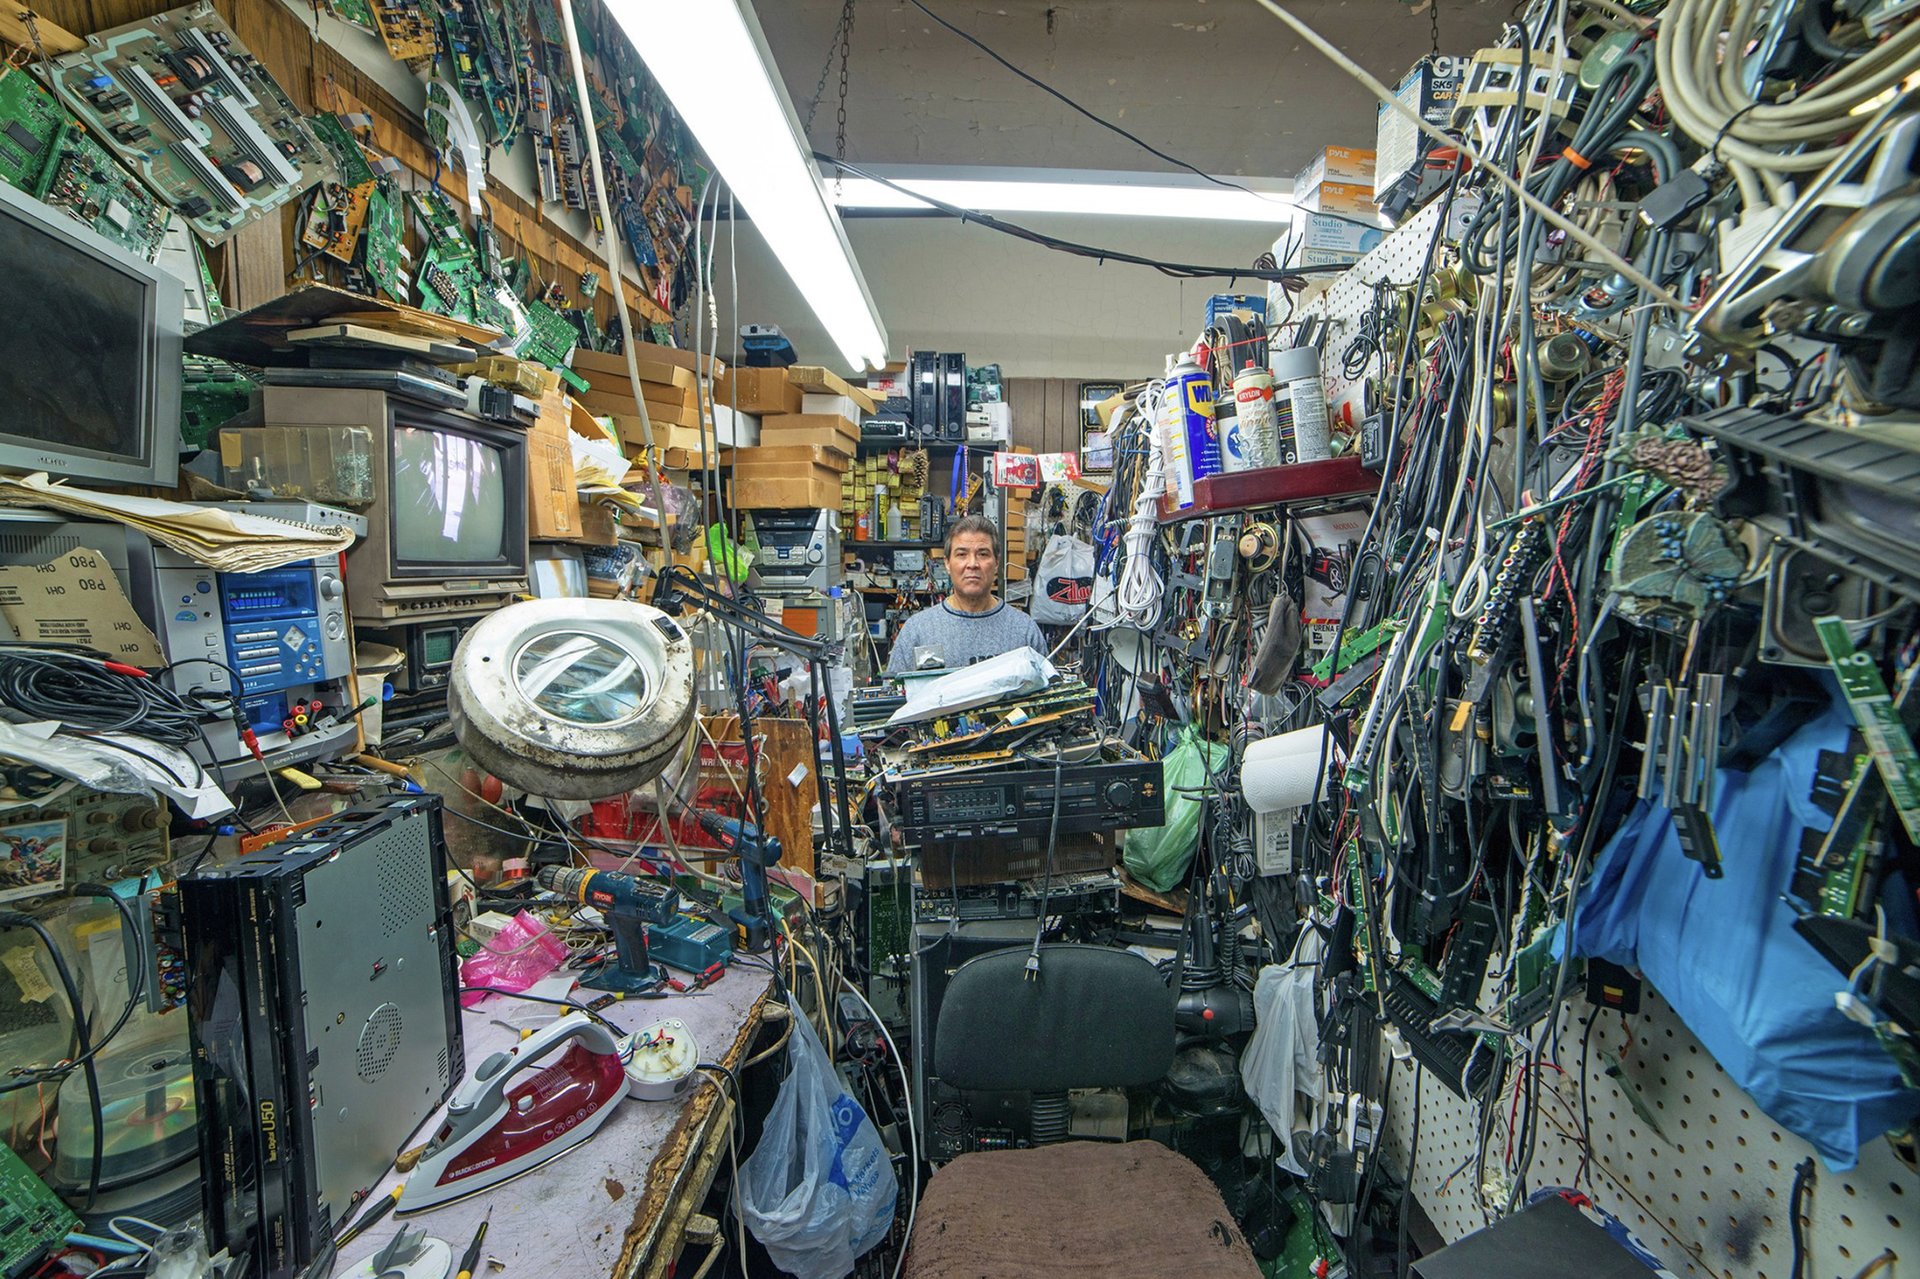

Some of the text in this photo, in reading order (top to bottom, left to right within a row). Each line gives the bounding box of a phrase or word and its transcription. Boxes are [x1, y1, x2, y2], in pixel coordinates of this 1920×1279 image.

[1432, 81, 1453, 89] SK5
[1433, 91, 1452, 100] CAR
[1328, 149, 1350, 159] PYLE
[1323, 185, 1344, 195] PYLE
[1312, 218, 1342, 228] Studio
[1306, 254, 1337, 264] Studio
[1238, 389, 1261, 402] KRYLON
[70, 556, 97, 568] P80
[46, 585, 66, 595] OH1
[79, 579, 106, 591] P80
[113, 622, 132, 631] OH1
[120, 643, 139, 652] OH1
[260, 1101, 275, 1132] U50
